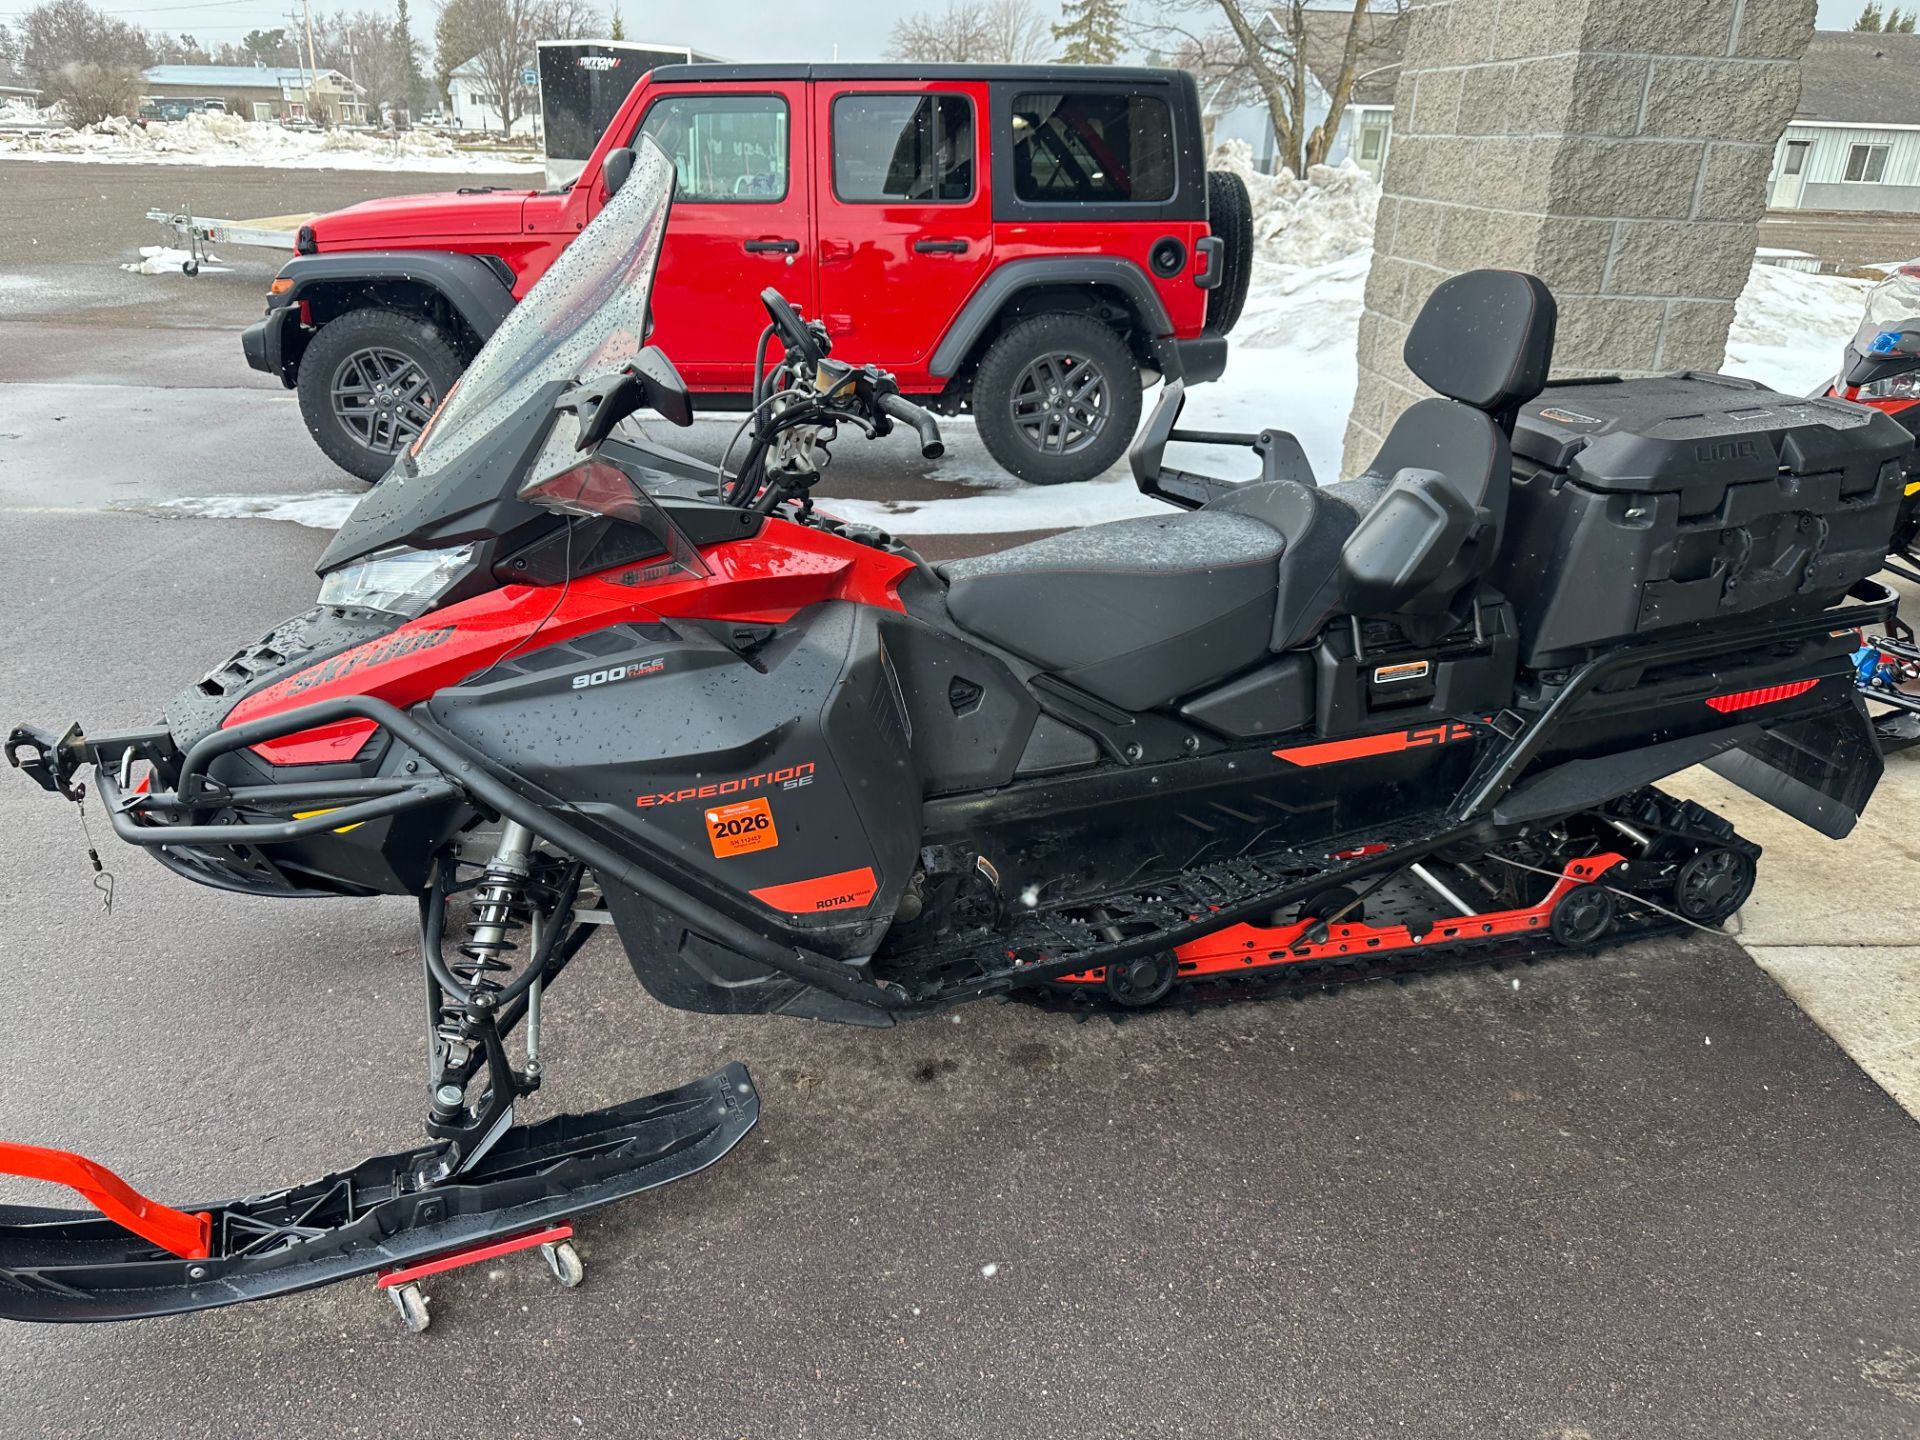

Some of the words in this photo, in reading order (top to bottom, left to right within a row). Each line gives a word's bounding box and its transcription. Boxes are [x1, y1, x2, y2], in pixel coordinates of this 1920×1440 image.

[572, 666, 626, 689] 900
[627, 657, 664, 673] ACE
[636, 762, 815, 808] EXPEDITION
[783, 775, 814, 791] SE
[713, 813, 769, 839] 2026
[816, 893, 855, 909] ROTAX
